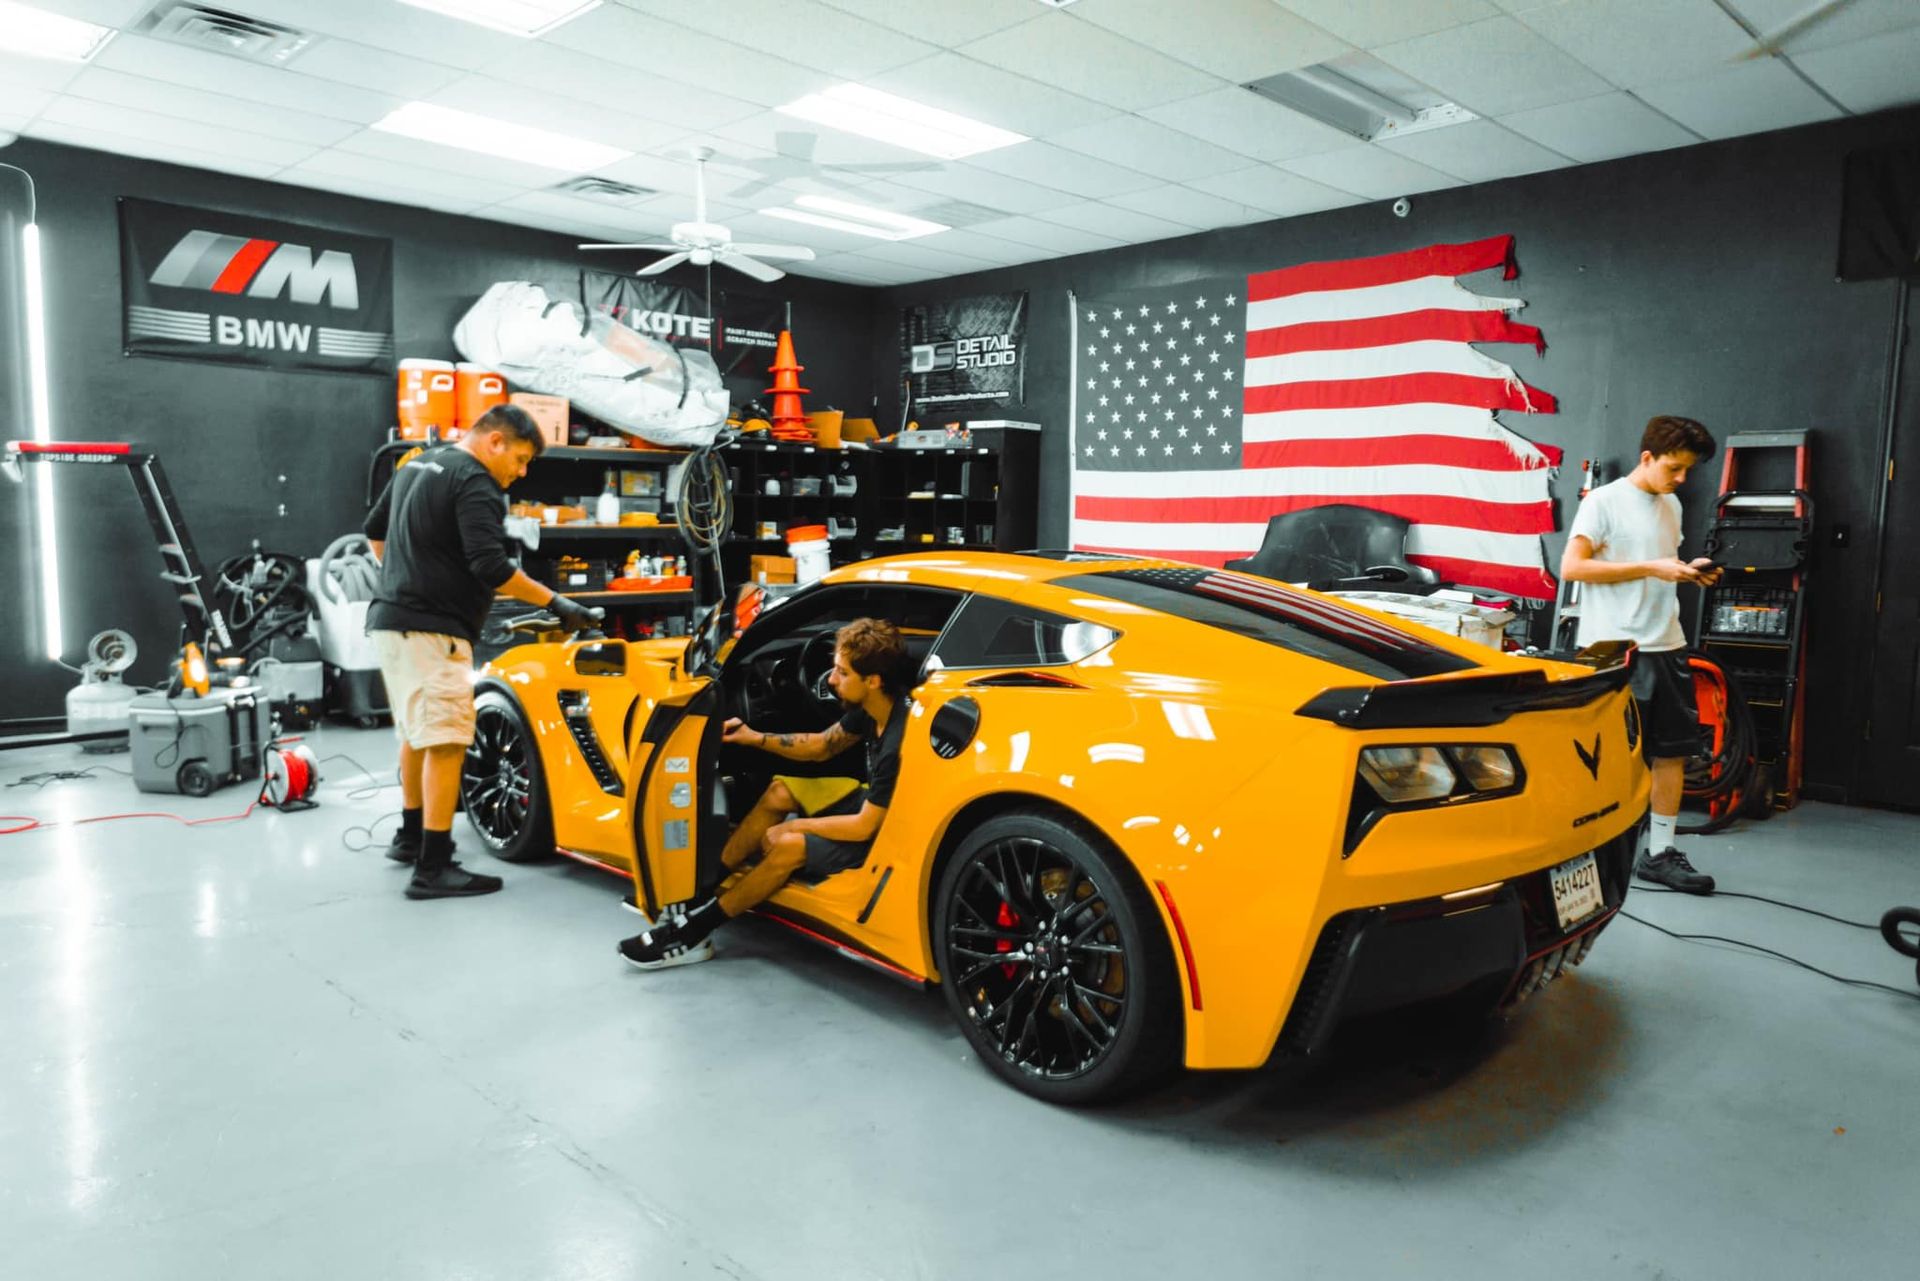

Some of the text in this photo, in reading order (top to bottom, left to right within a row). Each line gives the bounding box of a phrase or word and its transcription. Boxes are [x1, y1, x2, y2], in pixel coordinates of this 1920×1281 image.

[217, 314, 312, 352] BMW
[632, 308, 711, 339] KOTE
[911, 341, 956, 374] DS
[956, 334, 1016, 354] DETAIL
[956, 350, 1016, 370] STUDIO
